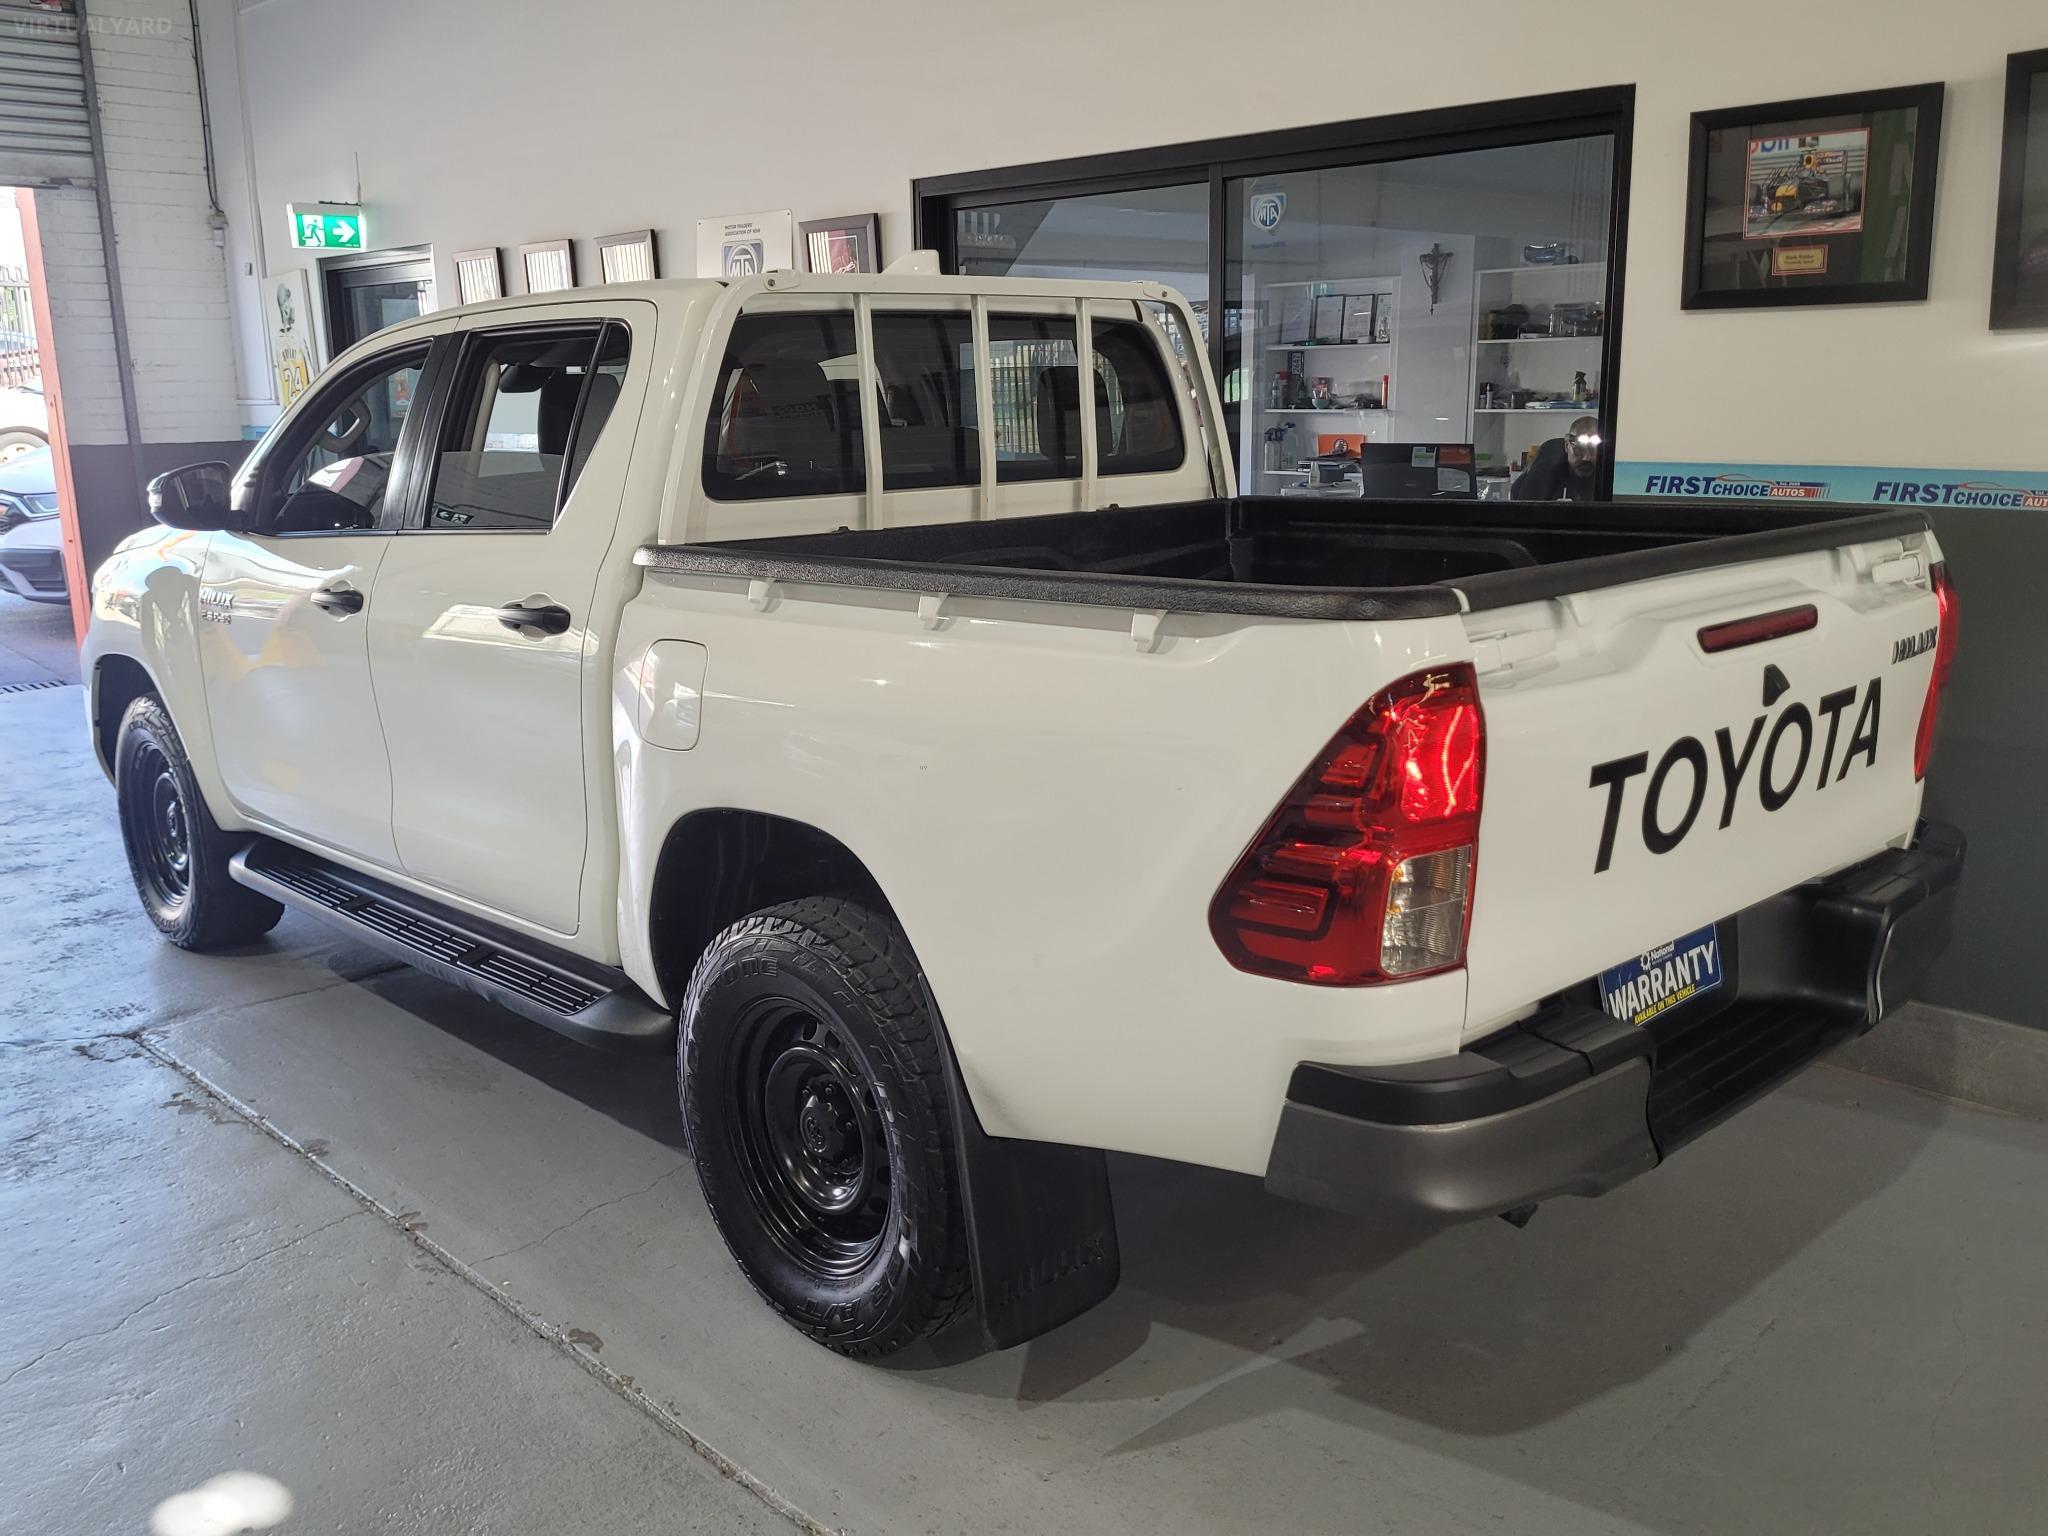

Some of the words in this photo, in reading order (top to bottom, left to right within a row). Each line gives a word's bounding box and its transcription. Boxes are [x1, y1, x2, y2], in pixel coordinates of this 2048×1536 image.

[282, 366, 304, 401] 24
[1645, 475, 1717, 495] FIRST
[1711, 483, 1769, 497] CHOICE
[1771, 487, 1805, 497] AUTOS
[1873, 481, 1959, 504] FIRST
[1953, 491, 2024, 507] CHOICE
[1588, 676, 1882, 875] TOYOTA
[1608, 940, 1715, 1021] WARRANTY
[1664, 995, 1676, 1007] THIS
[1675, 983, 1696, 1001] VEHICLE
